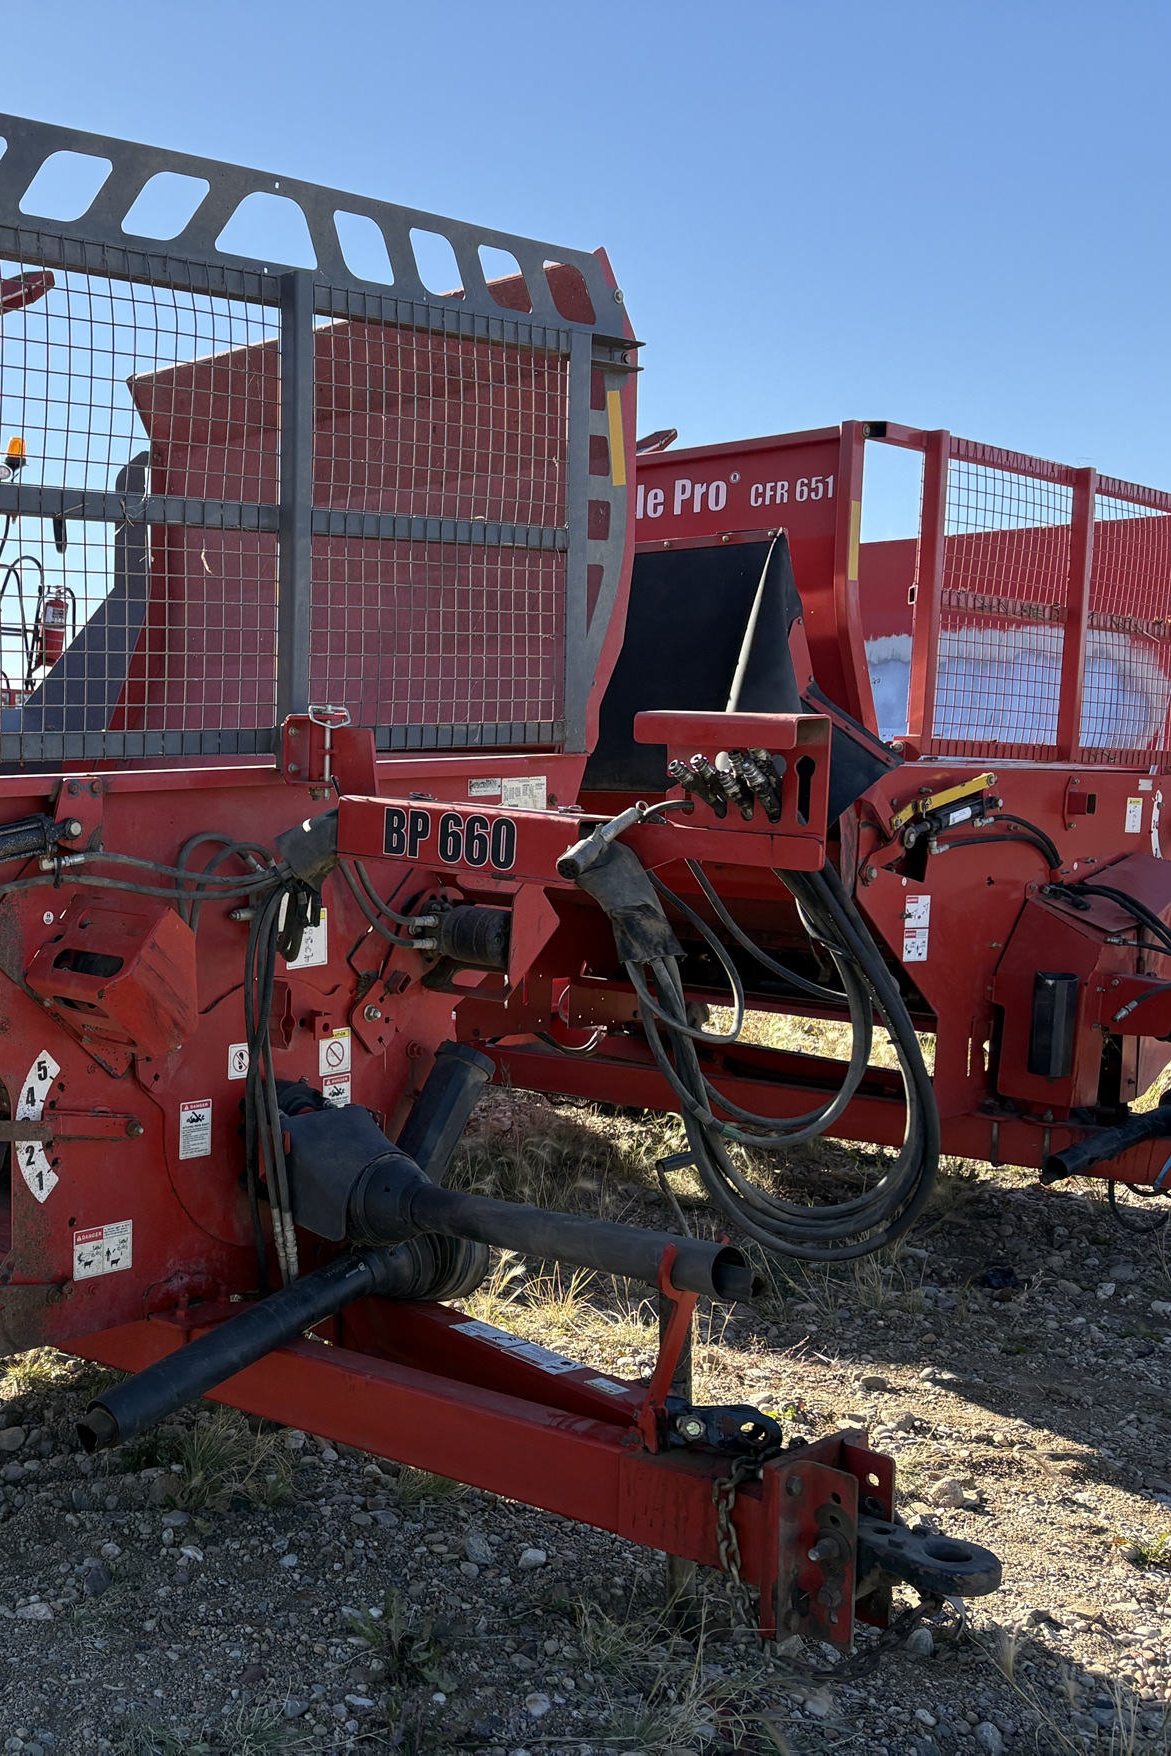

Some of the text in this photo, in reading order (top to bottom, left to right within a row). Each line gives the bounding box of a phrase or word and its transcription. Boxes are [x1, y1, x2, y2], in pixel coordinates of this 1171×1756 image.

[635, 484, 665, 520] le
[749, 480, 789, 508] CFR
[795, 474, 834, 503] 651
[383, 806, 517, 870] BP 660
[37, 1060, 48, 1081] 5
[26, 1086, 36, 1107] 4
[25, 1145, 35, 1166] 2
[35, 1170, 44, 1191] 1
[81, 1231, 102, 1240] DANGER
